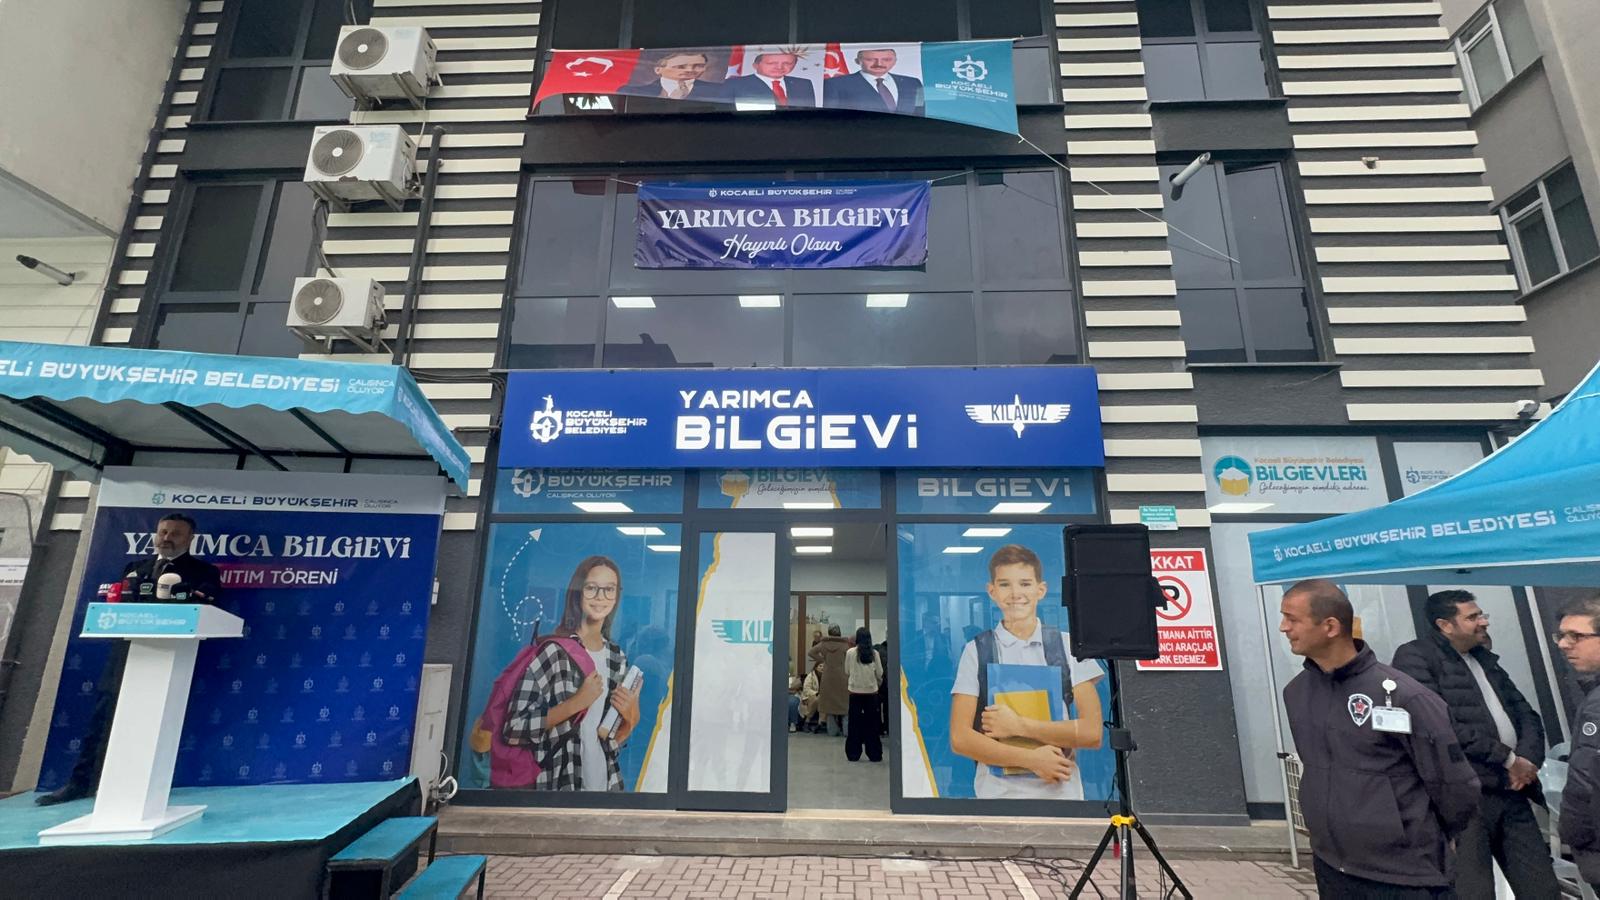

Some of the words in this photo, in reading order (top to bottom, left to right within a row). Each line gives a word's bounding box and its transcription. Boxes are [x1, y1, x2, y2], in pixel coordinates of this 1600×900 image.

[657, 208, 786, 230] YARIMCA
[720, 234, 787, 259] Hayırlı
[791, 233, 842, 256] Olsun
[679, 390, 814, 409] YARIMCA
[991, 404, 1048, 421] KILAVUZ
[123, 532, 273, 557] YAIMCA
[270, 567, 338, 584] TÖRENİ
[1175, 642, 1214, 654] ARAÇLAR
[1173, 654, 1207, 665] EDEMEZ
